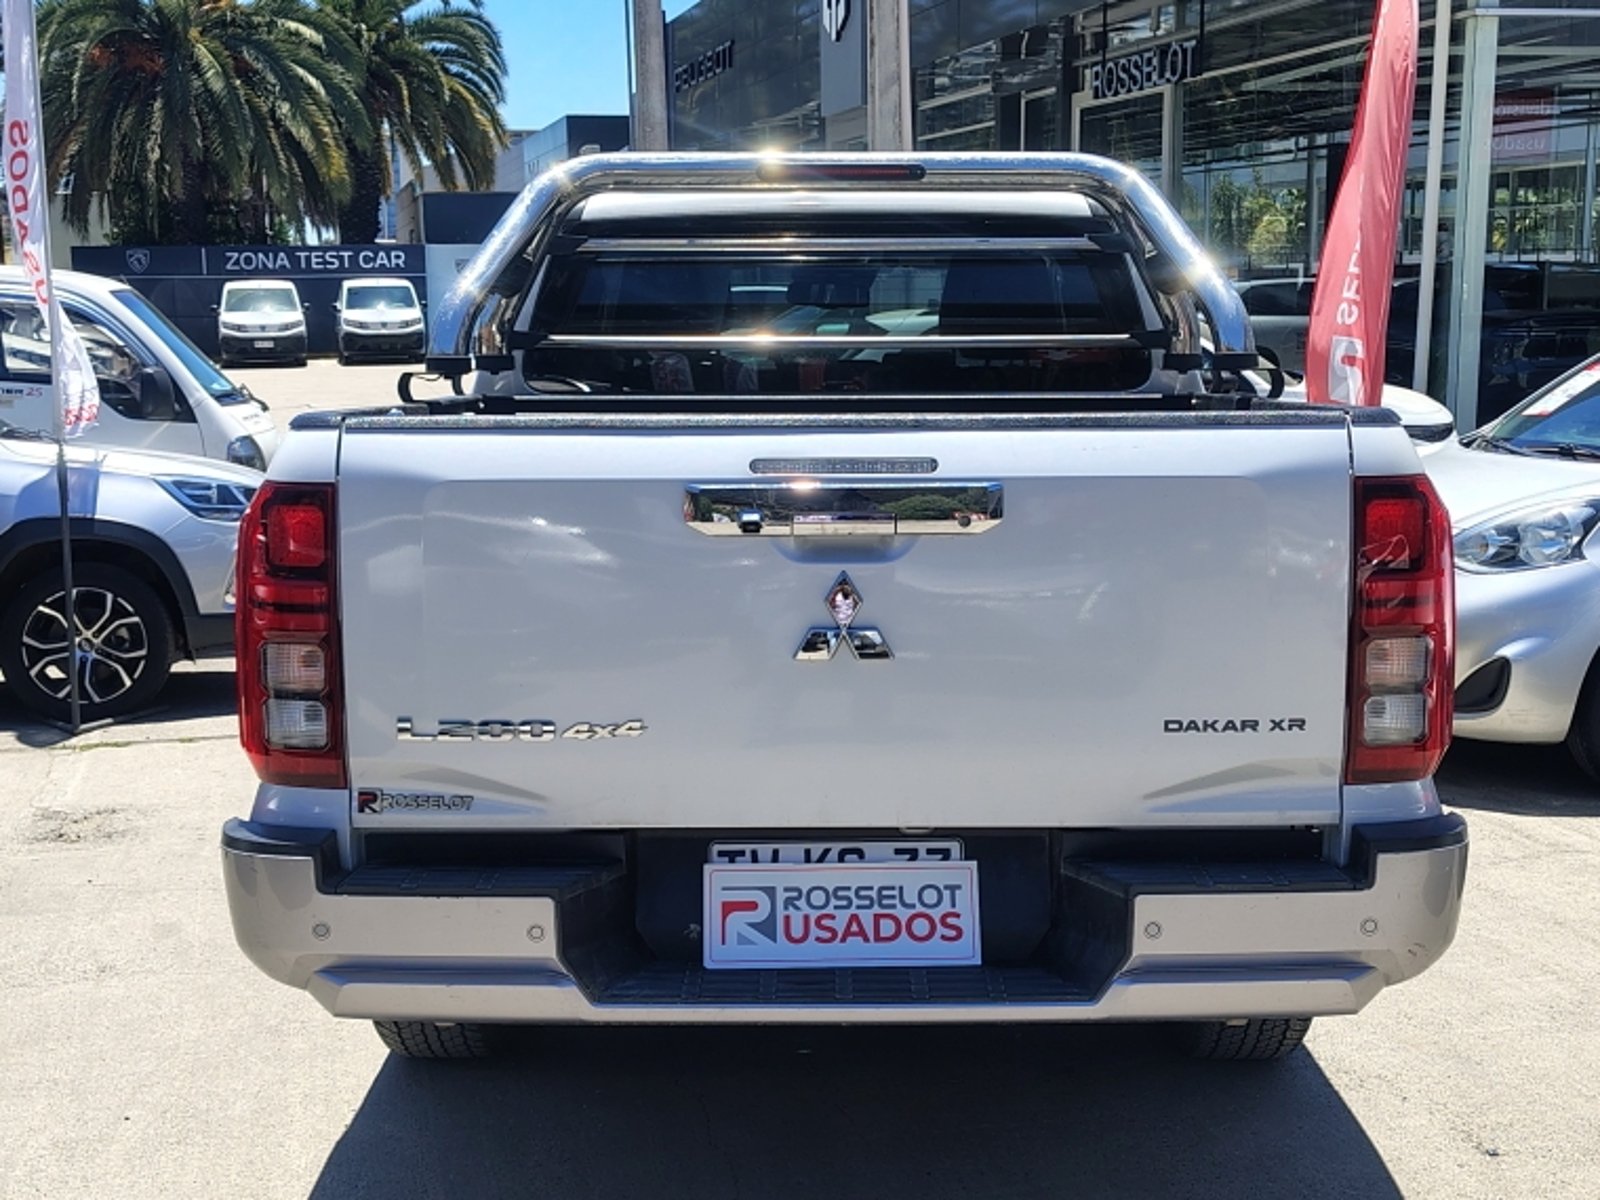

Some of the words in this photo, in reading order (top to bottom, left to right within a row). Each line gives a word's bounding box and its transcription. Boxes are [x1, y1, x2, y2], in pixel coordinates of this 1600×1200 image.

[1091, 40, 1197, 99] ROSSELOT
[224, 251, 291, 270] ZONA
[295, 251, 354, 269] TEST
[358, 250, 406, 269] CAR
[396, 716, 556, 743] L200
[560, 718, 649, 742] 4x4
[1163, 719, 1260, 733] DAKAR
[1268, 717, 1307, 732] XR
[782, 883, 964, 912] ROSSELOT
[782, 911, 965, 945] USADOS
